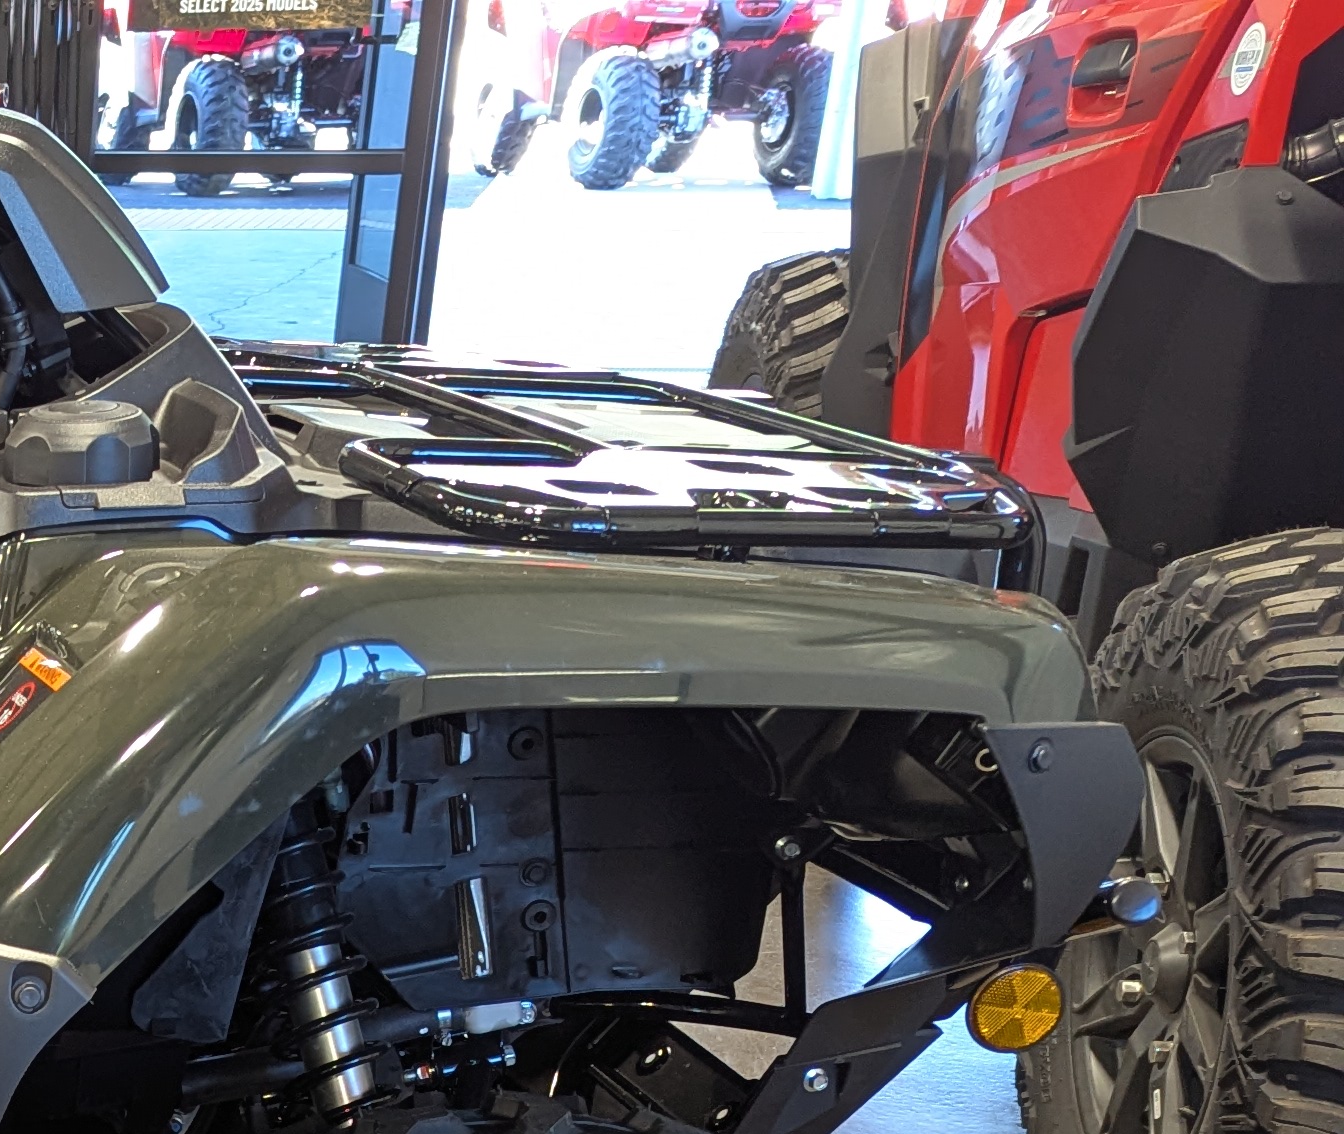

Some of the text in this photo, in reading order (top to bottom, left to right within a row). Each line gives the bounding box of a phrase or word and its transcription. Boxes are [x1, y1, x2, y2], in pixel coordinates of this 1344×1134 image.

[179, 0, 318, 13] SELECT 2025 MODELS
